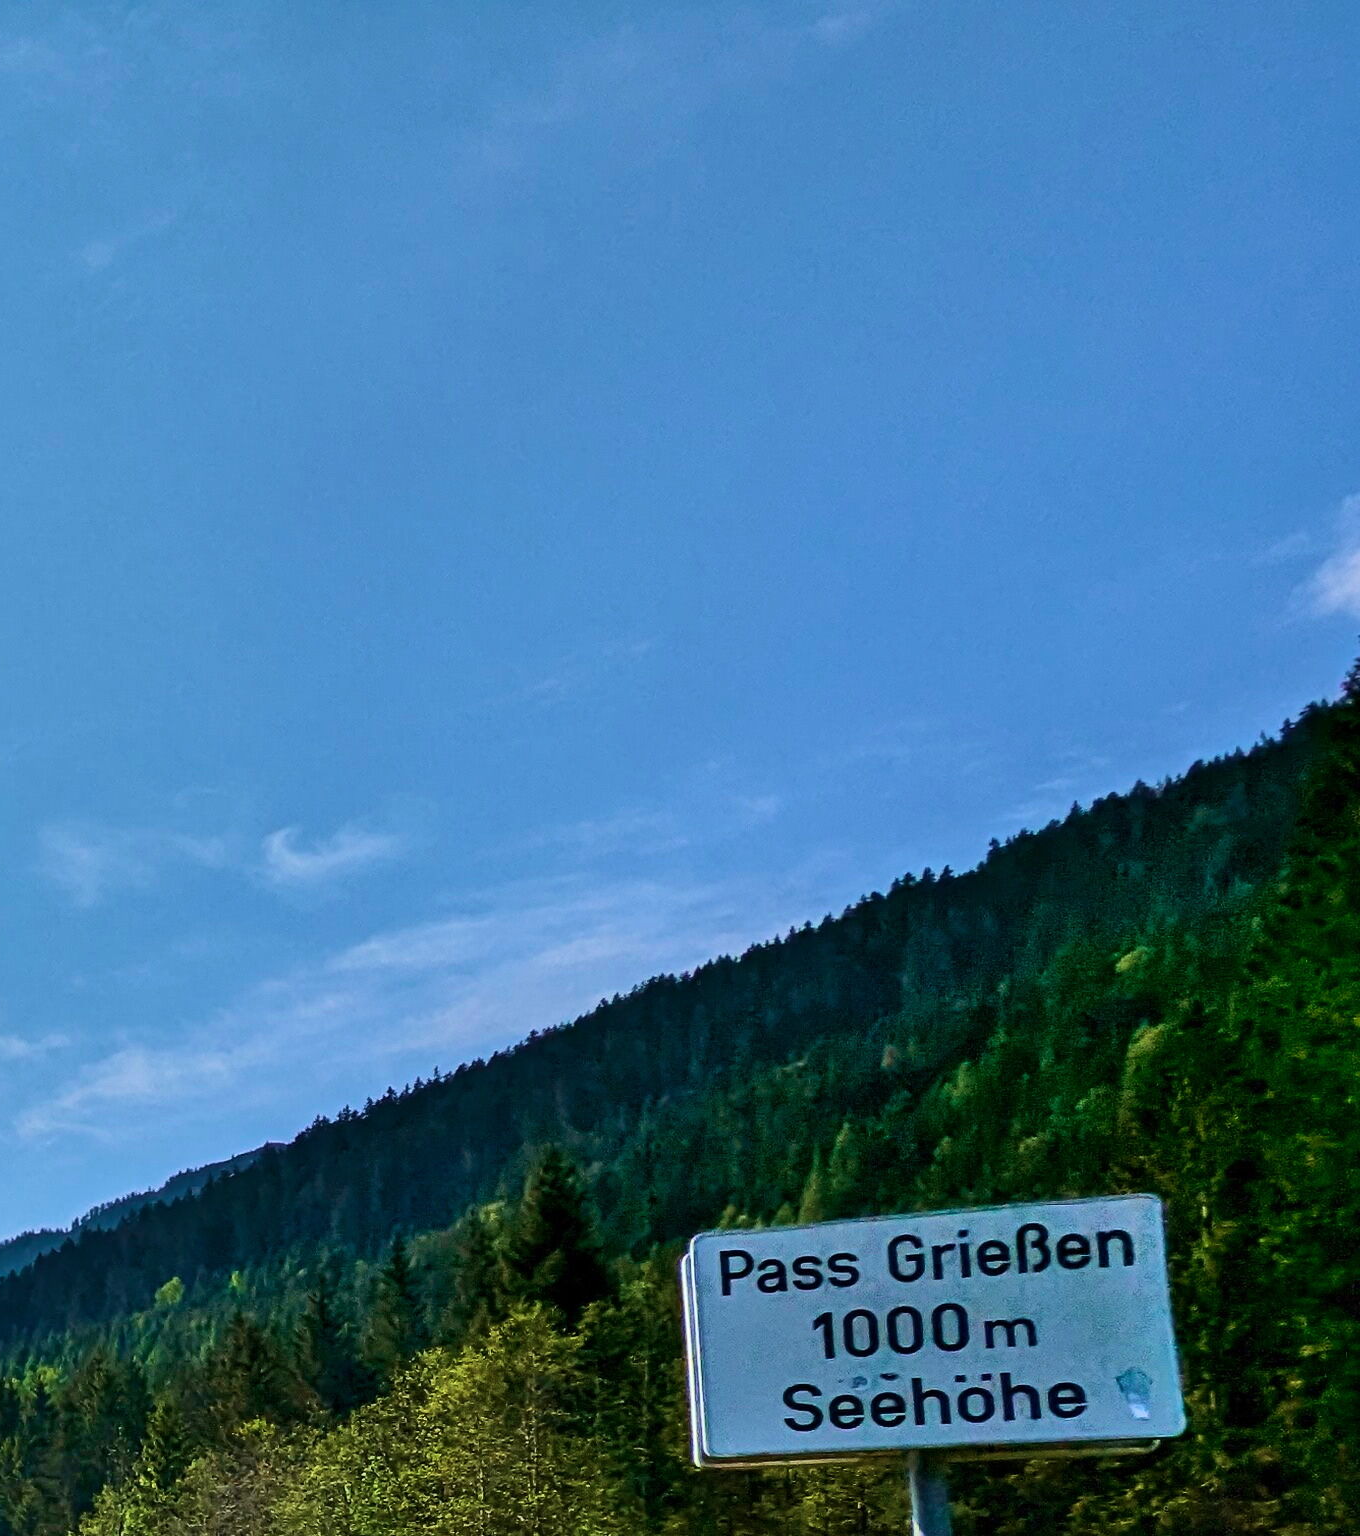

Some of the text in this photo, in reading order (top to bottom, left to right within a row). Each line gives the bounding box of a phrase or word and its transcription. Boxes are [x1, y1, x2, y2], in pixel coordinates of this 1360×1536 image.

[718, 1222, 1136, 1297] Pass Grießen
[812, 1302, 1039, 1361] 1000 m
[782, 1371, 1089, 1433] Seehöhe
